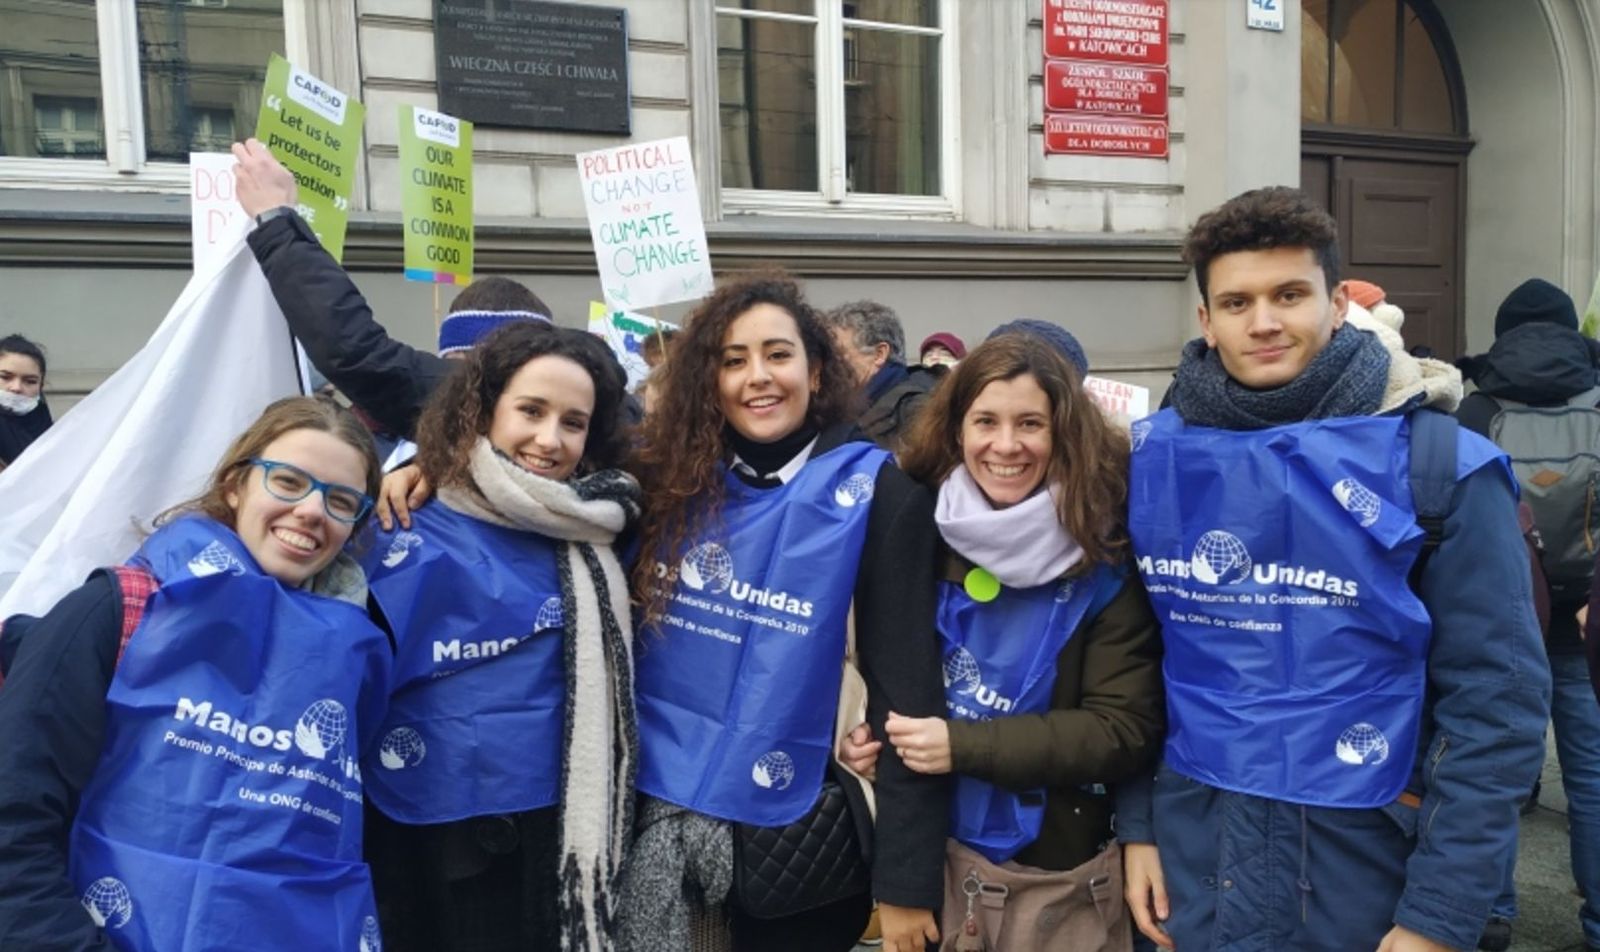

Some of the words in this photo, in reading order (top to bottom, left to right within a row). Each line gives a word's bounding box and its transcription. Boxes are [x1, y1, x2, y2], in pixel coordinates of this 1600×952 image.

[1079, 41, 1147, 56] KATOWICACH
[449, 55, 511, 73] WIECZNA
[514, 60, 553, 76] CZEŚĆ
[557, 64, 562, 76] I
[564, 64, 618, 82] CHWAŁA
[306, 125, 321, 141] us
[325, 131, 341, 151] be
[268, 133, 341, 177] protectors
[426, 146, 454, 167] OUR
[583, 143, 684, 179] POLITICAL
[413, 168, 466, 194] CLIMATE
[591, 168, 688, 204] CHANGE
[432, 196, 443, 214] IS
[445, 199, 454, 216] A
[622, 201, 653, 213] NOT
[411, 218, 469, 242] COMMON
[600, 212, 680, 245] CLIMATE
[426, 245, 460, 264] GOOD
[613, 239, 701, 278] CHANGE
[1088, 380, 1133, 400] CLEAN
[1253, 563, 1358, 597] Unidas
[730, 580, 813, 617] Unidas
[1255, 593, 1266, 604] la
[1269, 593, 1328, 606] Concordia
[174, 697, 293, 751] Manos
[164, 731, 213, 755] Premio
[268, 761, 285, 775] de
[239, 787, 266, 803] Una
[269, 792, 301, 810] ONG
